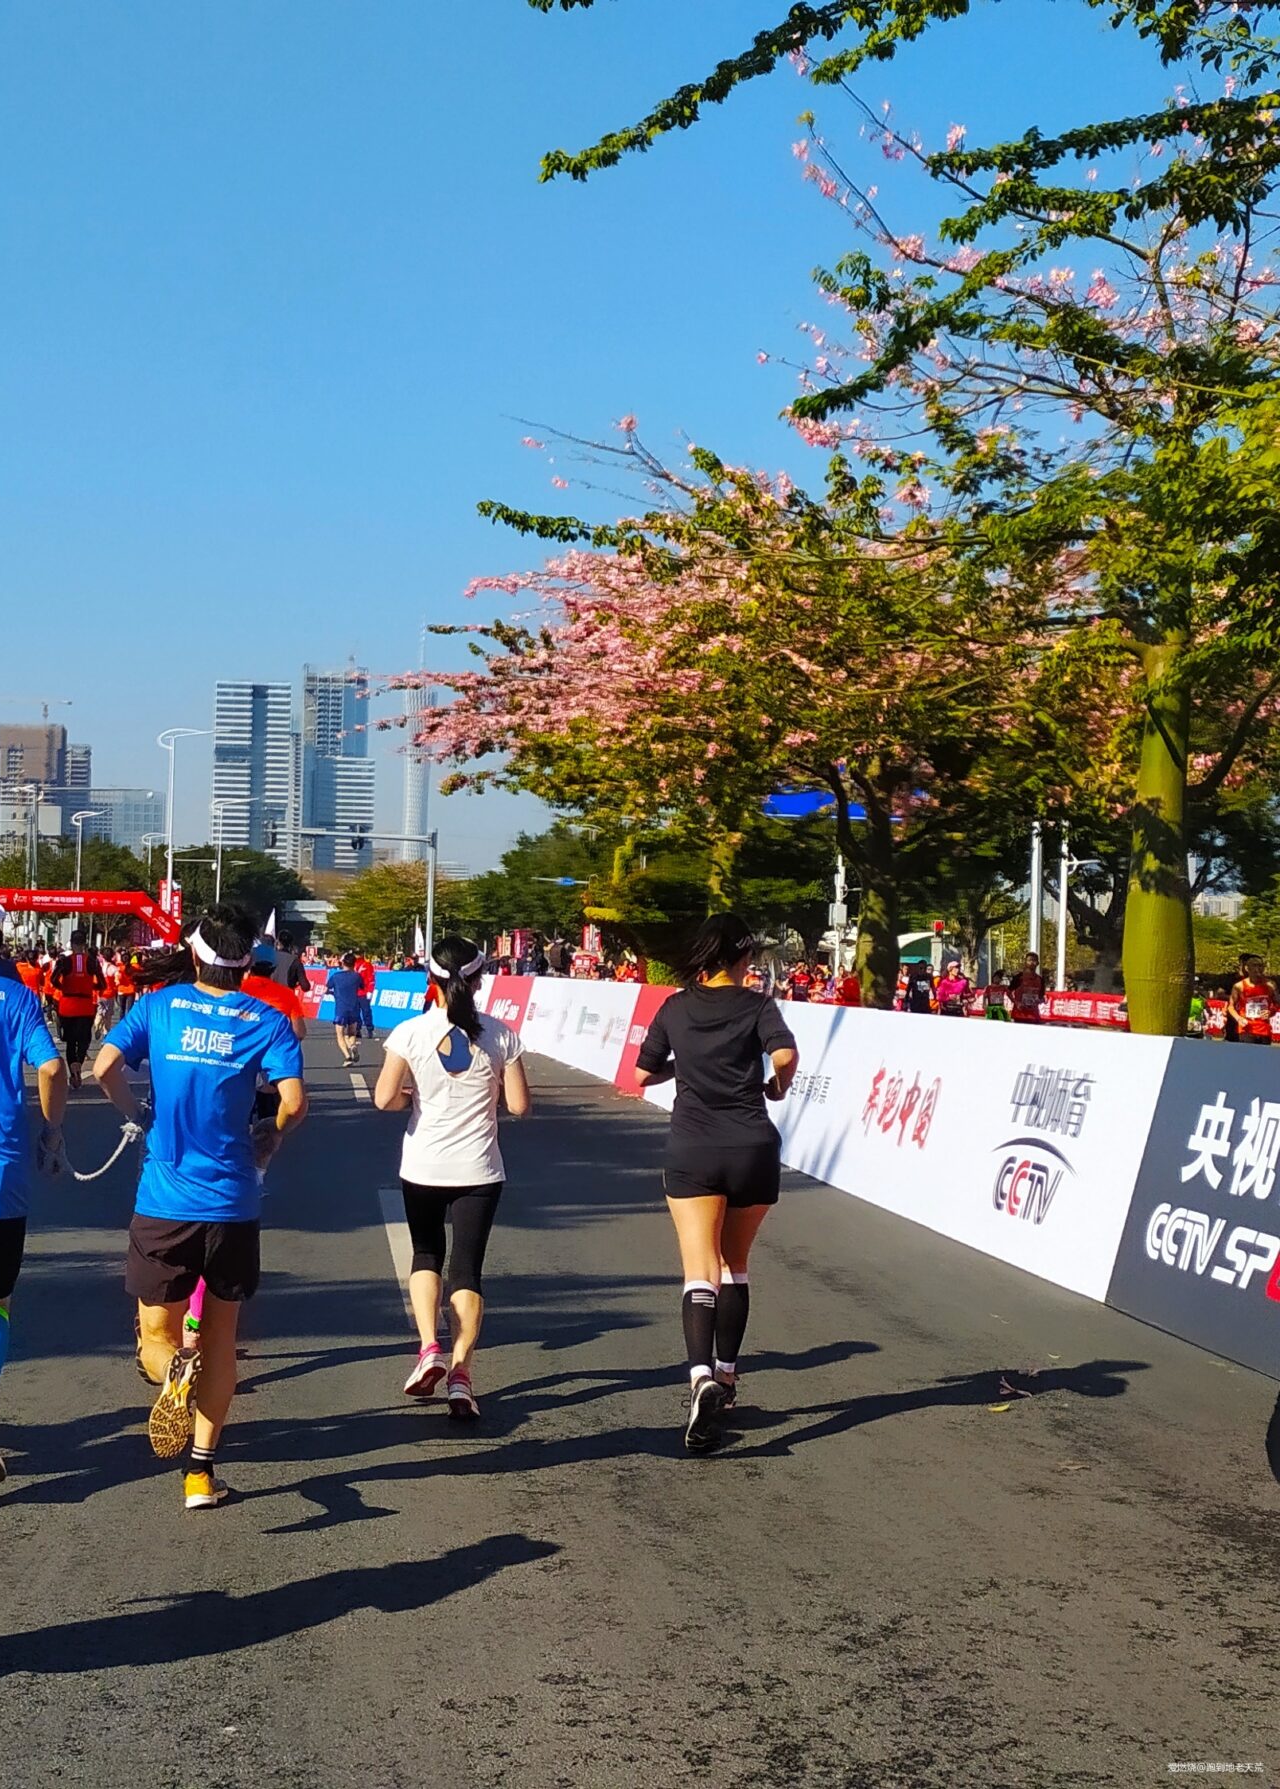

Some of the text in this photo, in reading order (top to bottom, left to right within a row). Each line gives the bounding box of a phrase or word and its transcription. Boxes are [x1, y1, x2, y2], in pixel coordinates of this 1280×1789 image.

[180, 1026, 236, 1057] 视障
[861, 1062, 942, 1149] 奔跑中国
[1180, 1091, 1280, 1200] 央视
[992, 1155, 1065, 1225] CCTV
[1145, 1202, 1280, 1297] CCTV SP
